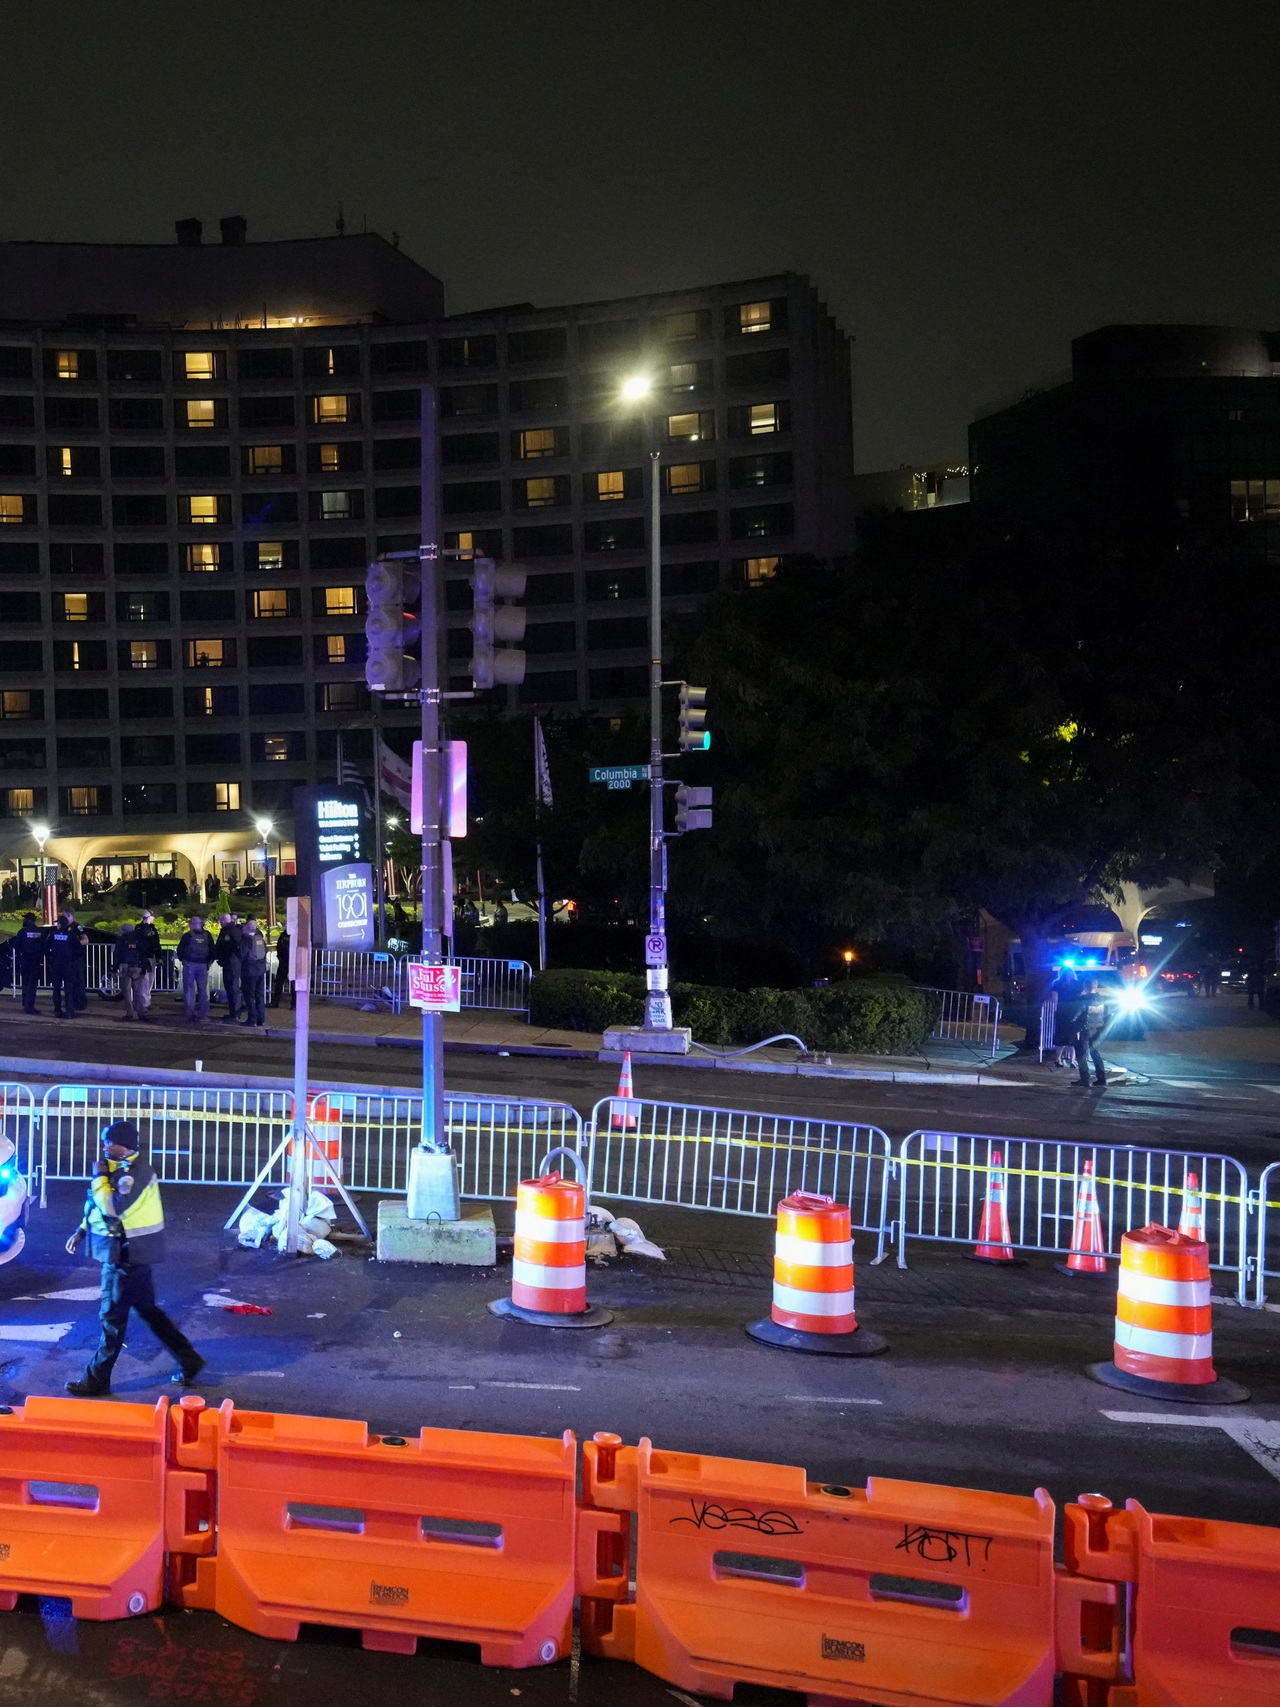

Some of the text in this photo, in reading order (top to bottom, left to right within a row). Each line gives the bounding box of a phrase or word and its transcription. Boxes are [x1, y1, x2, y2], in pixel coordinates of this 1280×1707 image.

[594, 767, 637, 780] Columbia
[608, 780, 631, 789] 2000
[318, 800, 358, 818] Hilton
[336, 878, 366, 890] HEPBURN
[336, 892, 368, 920] 1901
